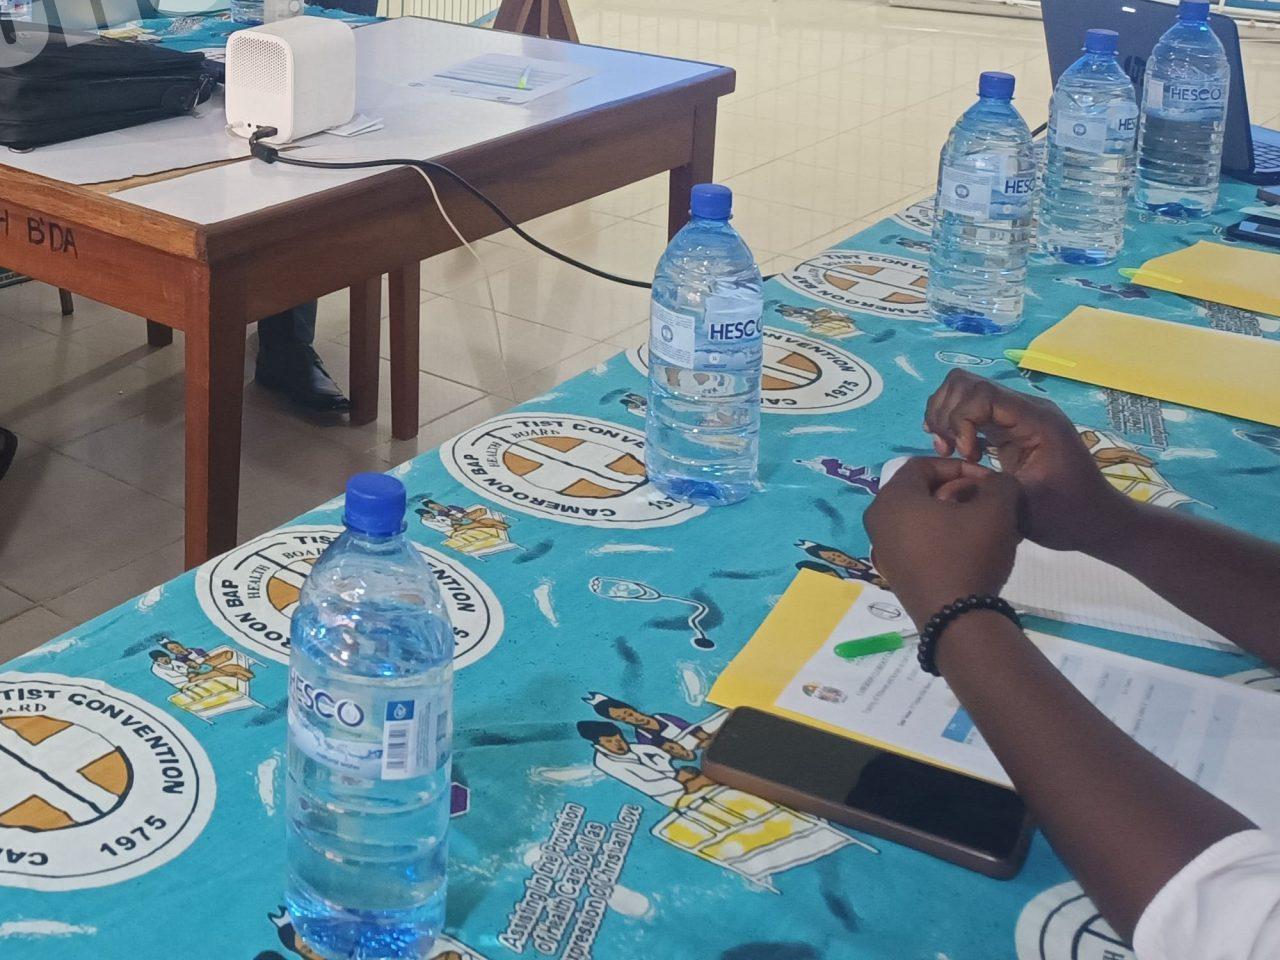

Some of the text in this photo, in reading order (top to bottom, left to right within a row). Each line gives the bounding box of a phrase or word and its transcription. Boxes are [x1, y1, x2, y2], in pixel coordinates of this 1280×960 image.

[1171, 88, 1222, 100] HESCO
[1119, 117, 1137, 131] HES
[1005, 178, 1036, 194] HESC
[824, 379, 860, 399] 1975
[516, 420, 647, 449] TIST CONVE
[463, 454, 616, 517] CAMEROON BAP
[220, 579, 243, 609] BAP
[248, 563, 270, 599] HEALTH
[428, 561, 476, 613] NTION
[67, 693, 185, 795] CONVENTION
[100, 814, 168, 858] 1975
